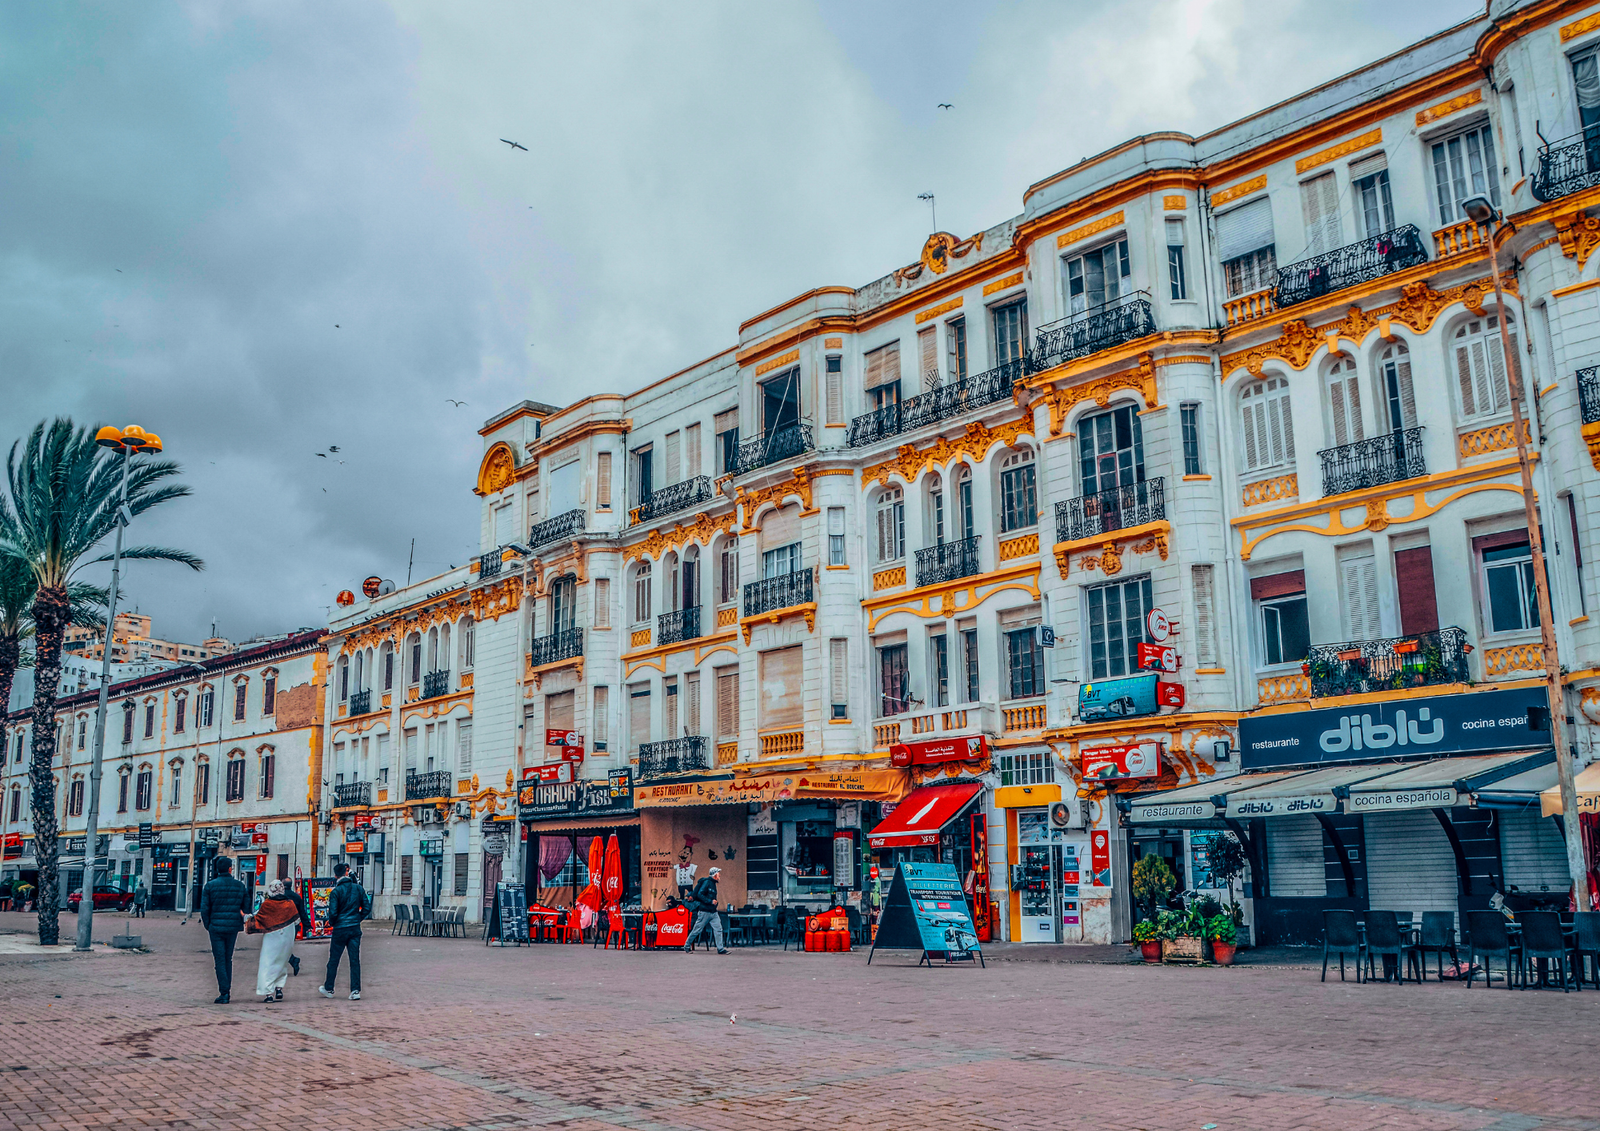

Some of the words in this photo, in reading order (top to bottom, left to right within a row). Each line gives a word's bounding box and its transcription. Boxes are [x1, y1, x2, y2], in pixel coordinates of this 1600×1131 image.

[1087, 689, 1101, 698] BVT
[1462, 718, 1496, 730] cocina
[1252, 737, 1300, 750] restaurante
[536, 783, 577, 805] NAHDA
[651, 784, 694, 798] RESTAURANT
[1355, 794, 1392, 806] cocina
[1395, 789, 1450, 807] española
[1142, 803, 1203, 818] restaurante
[661, 923, 684, 933] Coca-Cola
